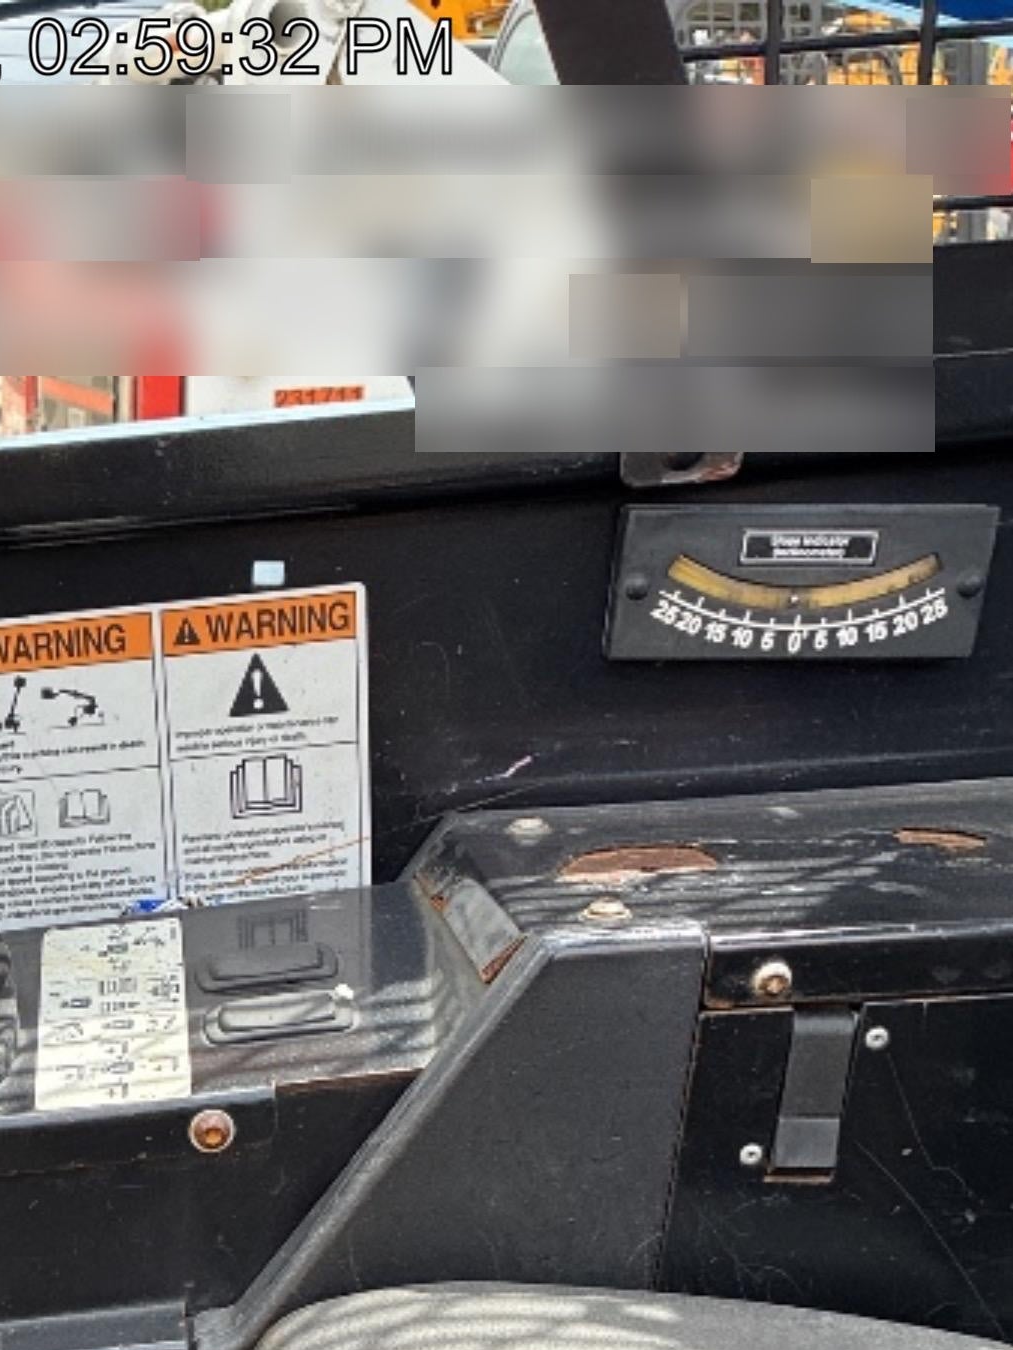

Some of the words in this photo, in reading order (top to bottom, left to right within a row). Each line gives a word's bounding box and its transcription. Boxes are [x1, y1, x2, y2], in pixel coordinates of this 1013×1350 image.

[207, 601, 350, 642] WARNING
[650, 600, 677, 622] 25
[674, 614, 702, 635] 20
[705, 621, 726, 643] 15
[732, 626, 753, 649] 10
[837, 626, 859, 647] 10
[866, 621, 888, 643] 15
[892, 611, 919, 636] 20
[919, 597, 948, 620] 25
